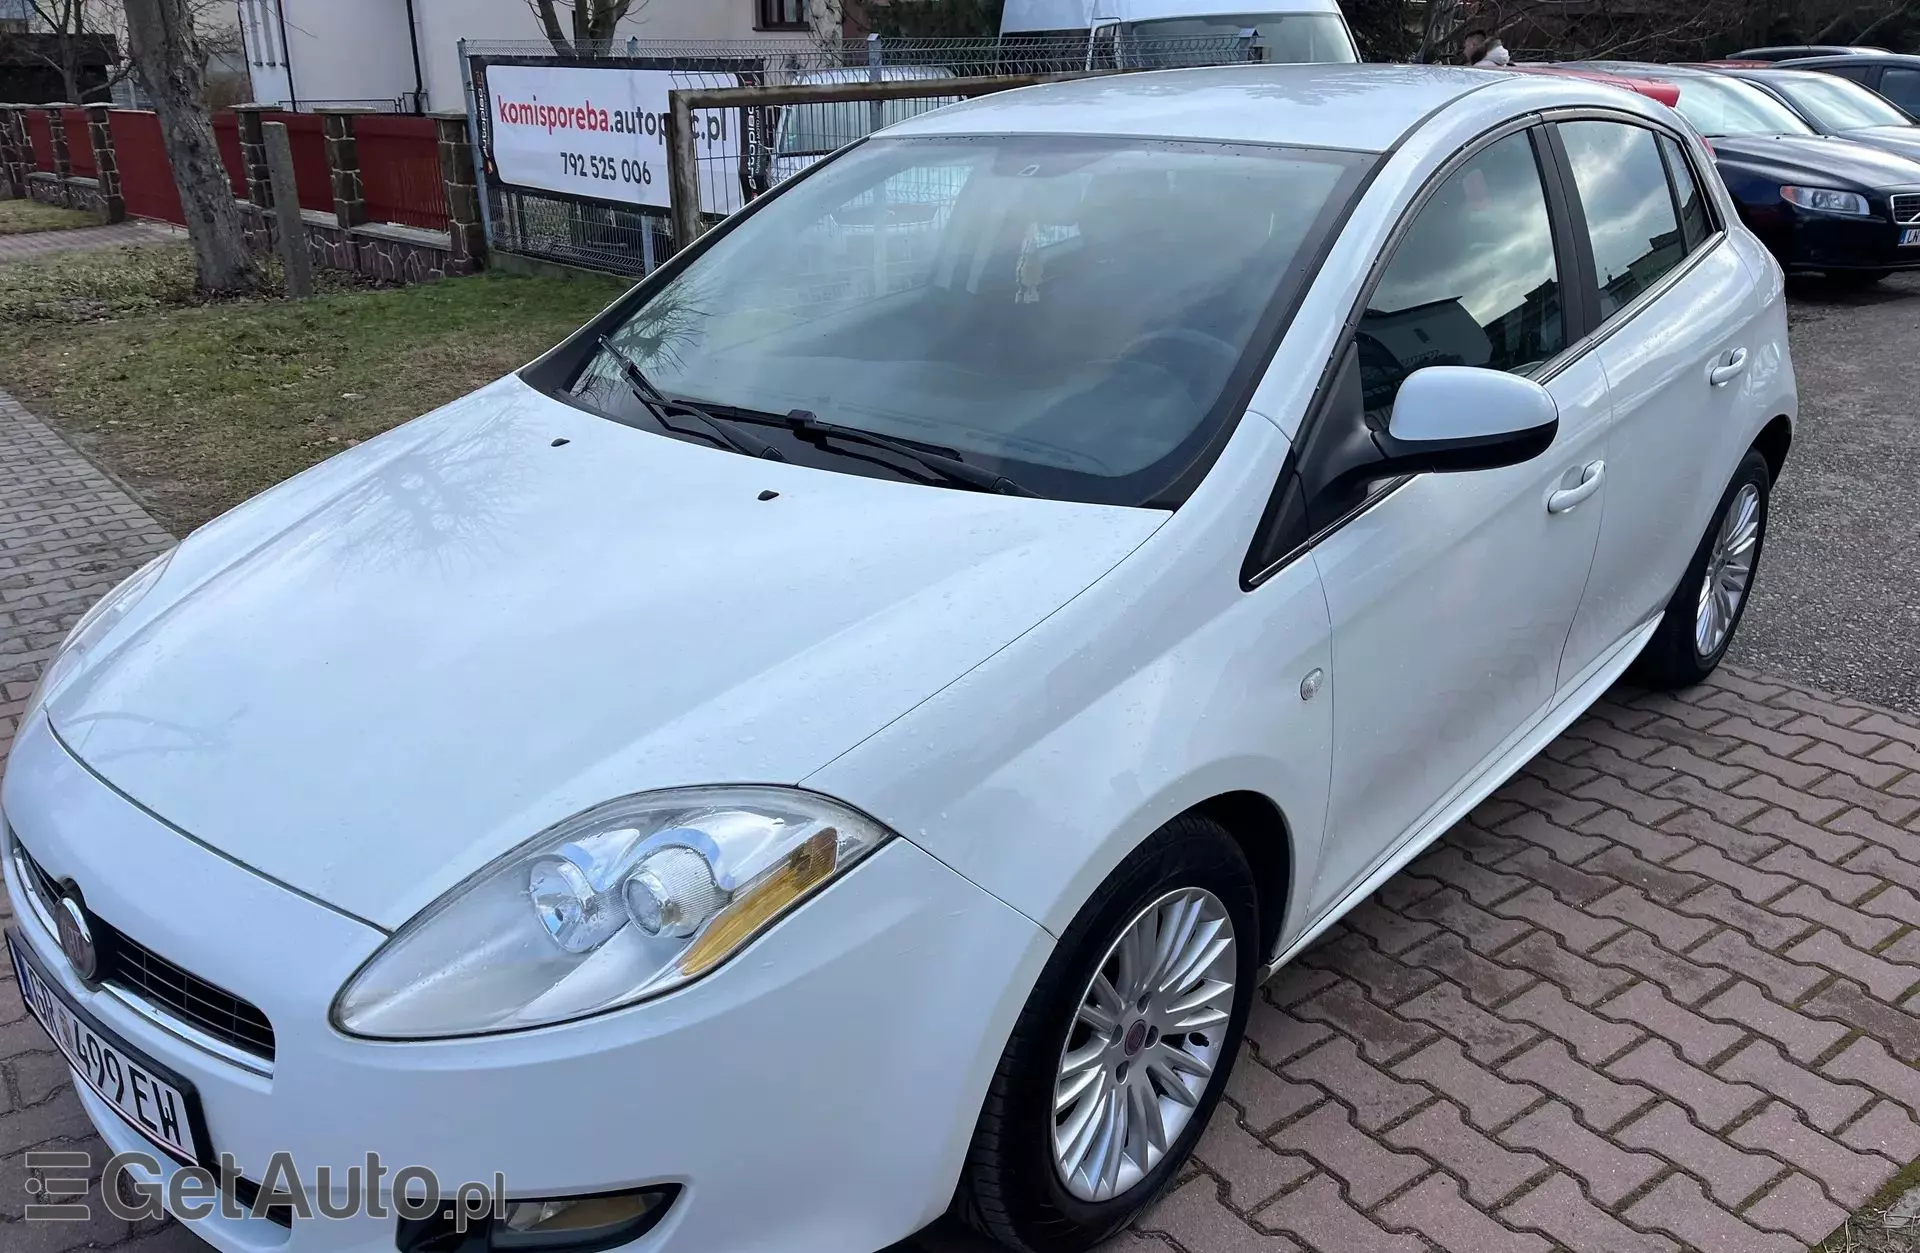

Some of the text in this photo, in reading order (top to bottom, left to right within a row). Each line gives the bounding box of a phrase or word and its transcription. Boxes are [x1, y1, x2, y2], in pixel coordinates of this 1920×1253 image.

[497, 94, 726, 150] komisporeba.autopc.pl
[560, 151, 652, 185] 792 525 006
